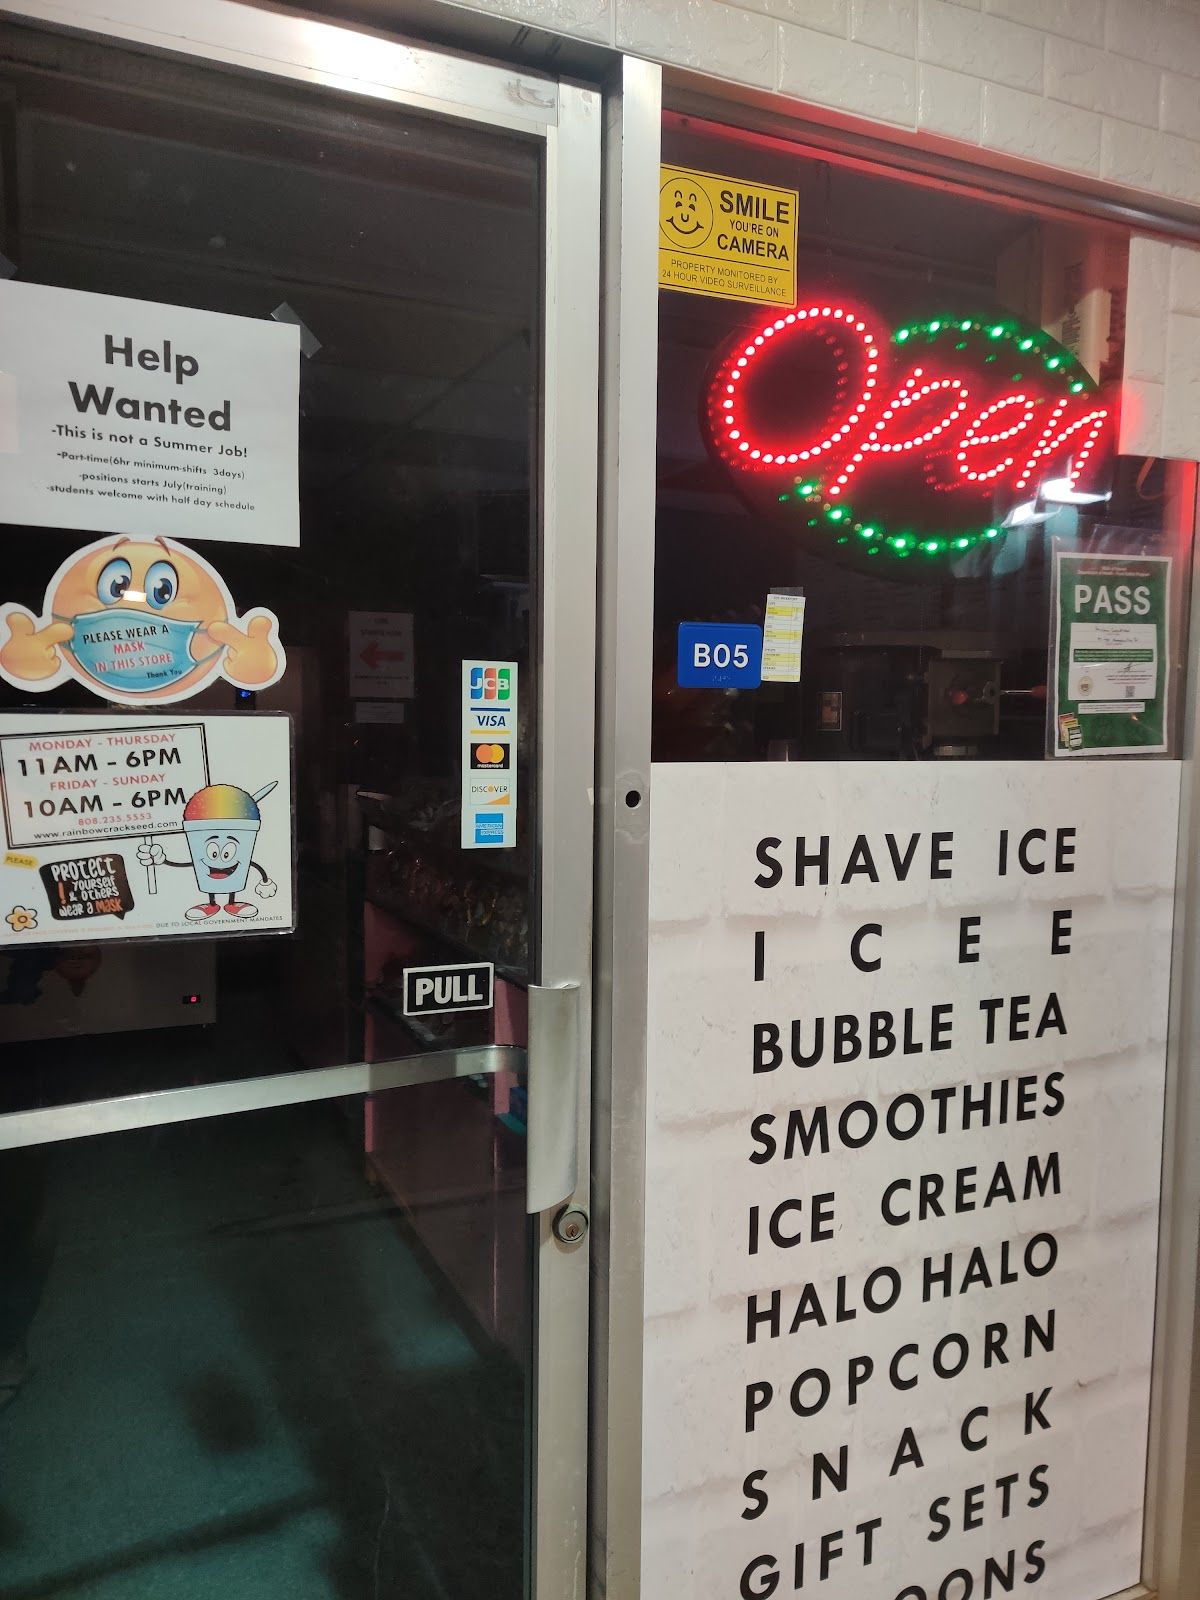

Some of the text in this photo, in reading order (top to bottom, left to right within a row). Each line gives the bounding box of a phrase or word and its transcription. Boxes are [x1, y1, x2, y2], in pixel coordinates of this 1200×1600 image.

[719, 190, 790, 224] SMILE
[729, 219, 779, 238] YOU'RE ON
[717, 233, 790, 261] CAMERA
[662, 268, 786, 297] 24 HOUR VIDEO SURVEILLANCE
[671, 258, 778, 284] PROPERTY MONITORED BY
[104, 333, 200, 385] Help
[67, 381, 232, 432] Wanted
[725, 307, 1108, 495] Open
[51, 424, 247, 458] -This is not a Summer Job!
[79, 472, 227, 496] -positions starts July(training)
[133, 459, 207, 475] minimum-shifts
[213, 468, 245, 480] 3days)
[47, 485, 255, 511] -students welcome with half day schedule
[1074, 584, 1151, 616] PASS
[82, 624, 169, 645] PLEASE WEAR A
[113, 641, 145, 655] MASK
[95, 653, 173, 673] IN THIS STORE
[146, 669, 182, 679] Thank You
[476, 715, 506, 727] VISA
[29, 739, 93, 752] MONDAY
[106, 733, 176, 747] THURSDAY
[17, 753, 99, 777] 11AM
[125, 747, 182, 769] 6PM
[50, 779, 98, 791] FRIDAY
[112, 773, 167, 786] SUNDAY
[471, 784, 508, 793] DISCOVER
[23, 794, 104, 819] 10AM
[130, 787, 187, 809] 6PM
[33, 820, 178, 840] www.rainbowcrackseed.com
[754, 827, 1076, 889] SHAVE ICE
[181, 919, 202, 927] LOCAL
[203, 917, 247, 925] GOVERNMENT
[415, 974, 483, 1006] PULL
[753, 992, 1068, 1074] BUBBLE TEA
[748, 1071, 1065, 1165] SMOOTHIES
[748, 1151, 1062, 1255] ICE CREAM
[746, 1232, 1058, 1344] HALO HALO
[745, 1309, 1056, 1433] POPCORN
[739, 1464, 1050, 1600] GIFT SETS
